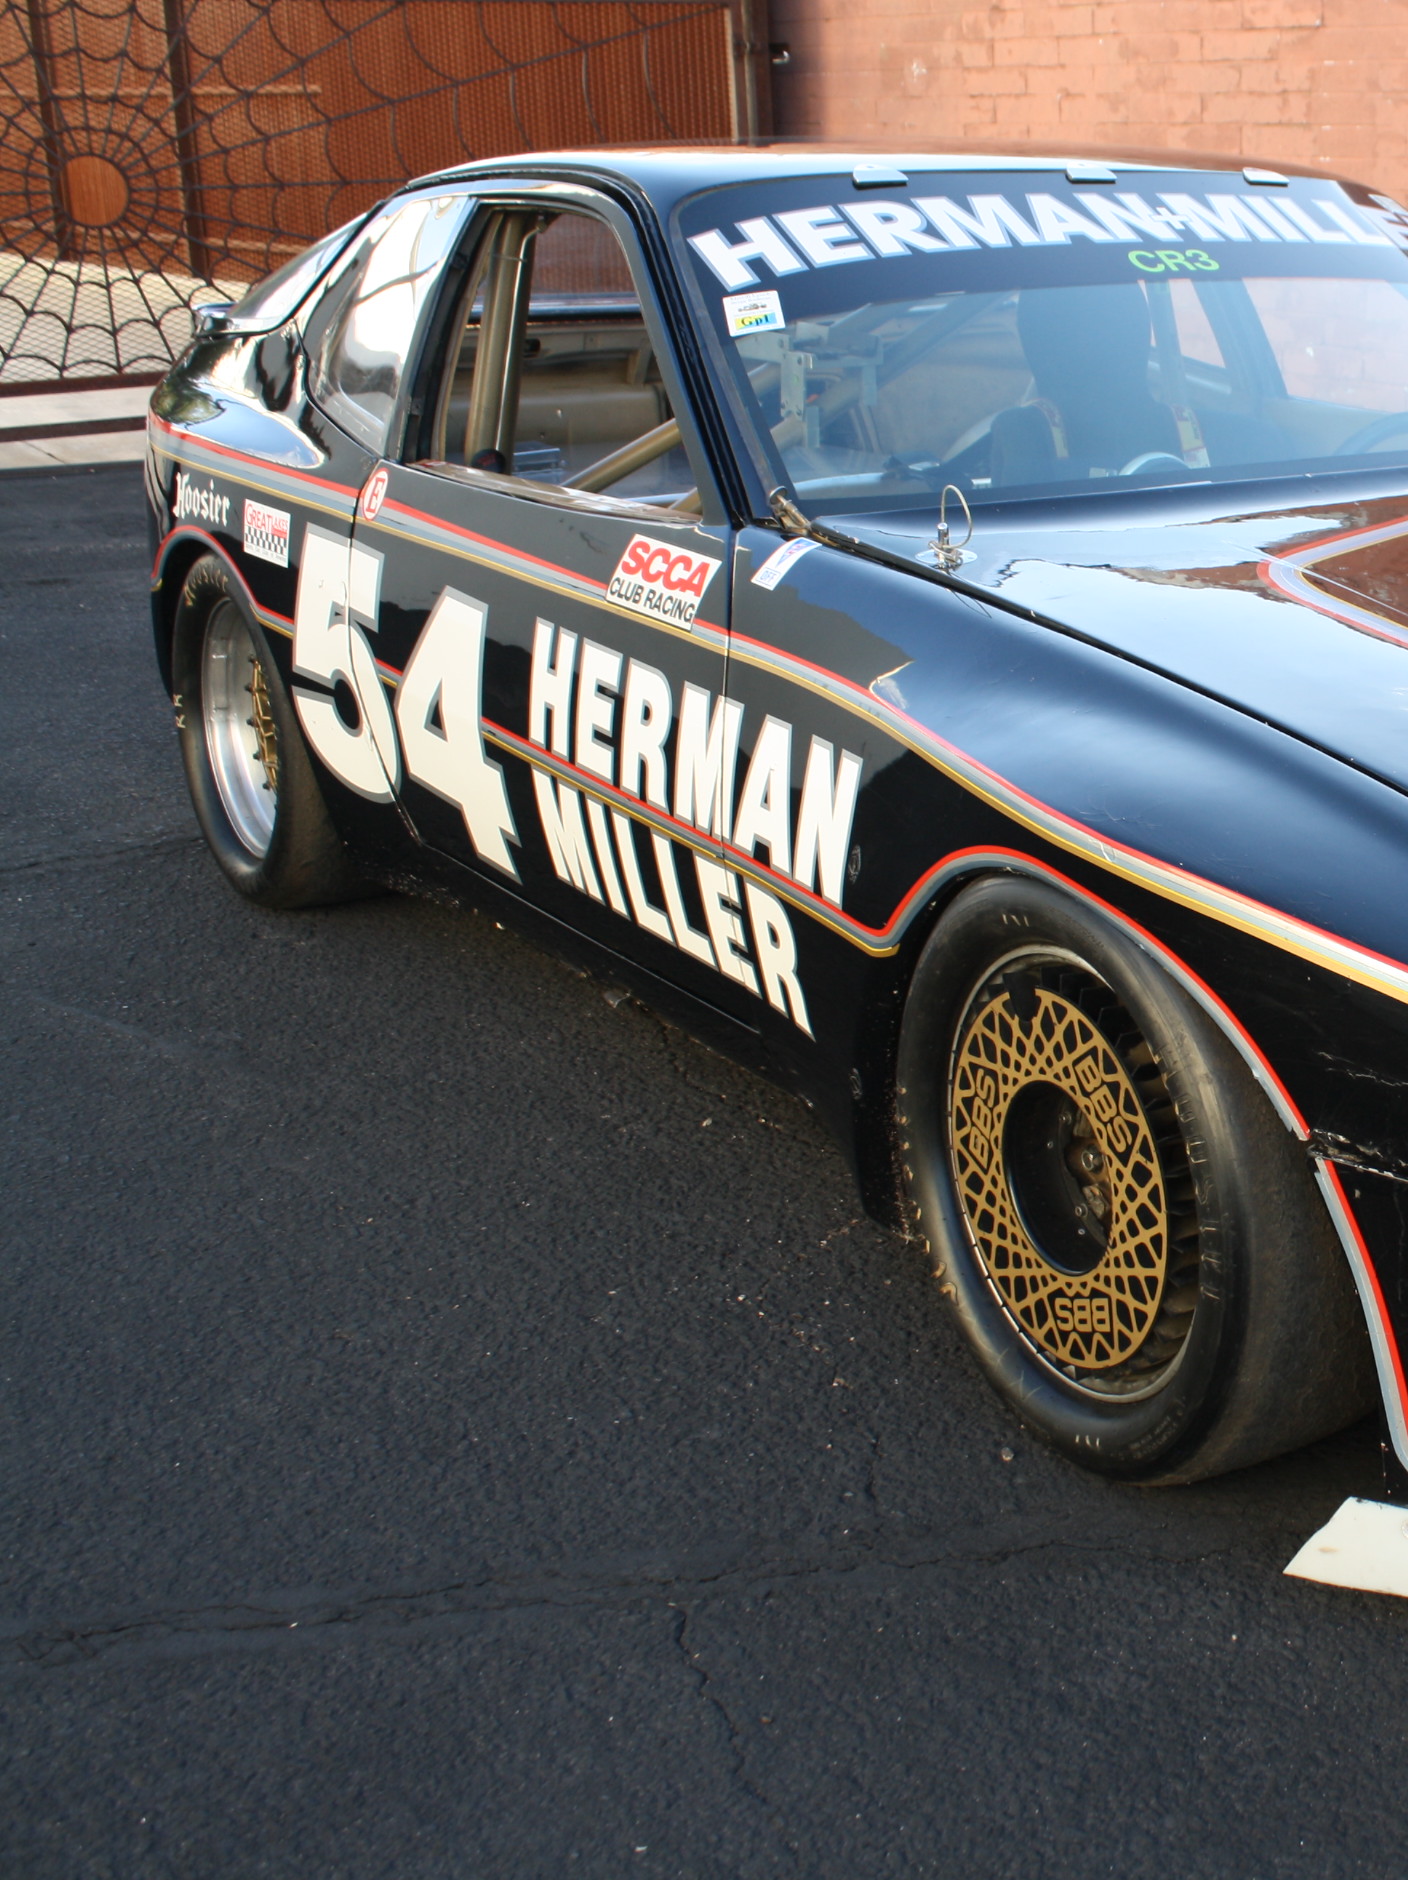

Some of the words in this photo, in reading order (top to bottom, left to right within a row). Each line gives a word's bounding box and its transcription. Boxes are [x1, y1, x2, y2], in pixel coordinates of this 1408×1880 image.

[1128, 248, 1220, 274] CR3
[173, 472, 230, 527] Hoosier
[245, 503, 272, 534] GREAT
[621, 540, 711, 597] SCCA
[610, 577, 642, 604] CLUB
[643, 588, 695, 623] RACING
[292, 522, 522, 884] 54
[528, 617, 863, 911] HERMAN
[530, 764, 816, 1041] MILLER
[968, 1068, 997, 1167] BBS
[1074, 1054, 1134, 1155] BBS
[1055, 1297, 1111, 1333] BBS
